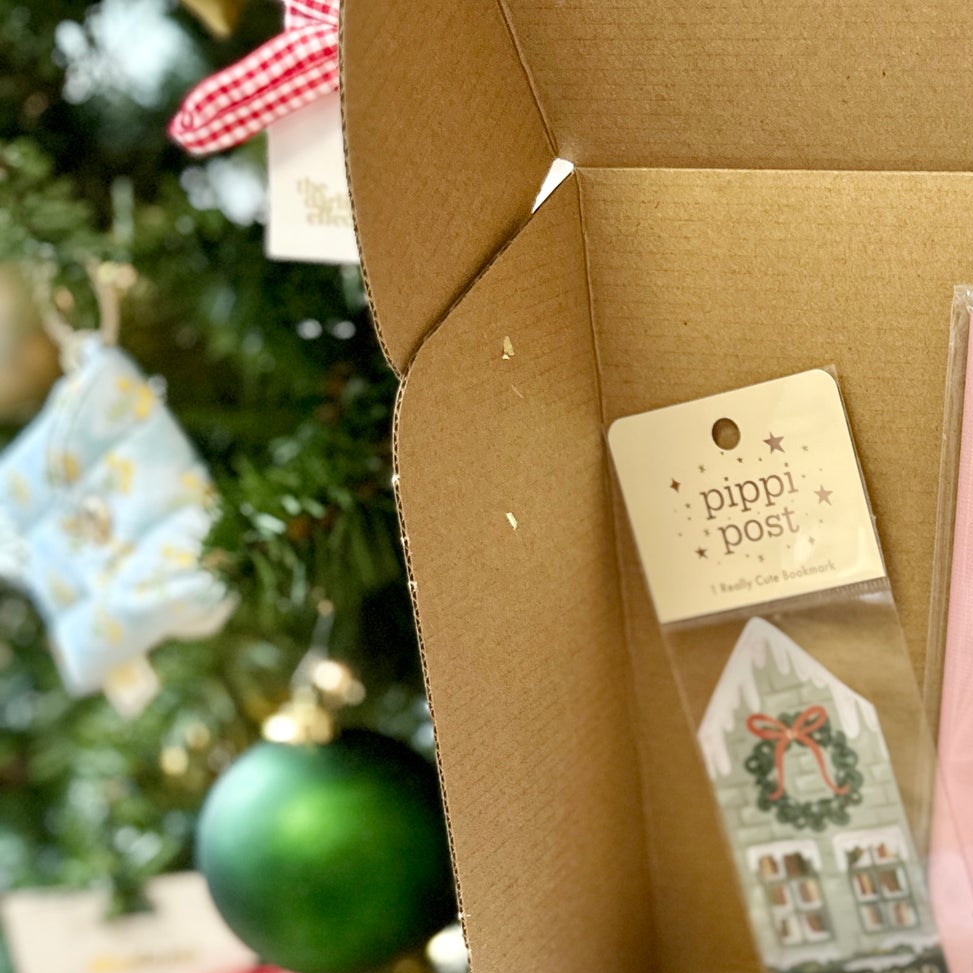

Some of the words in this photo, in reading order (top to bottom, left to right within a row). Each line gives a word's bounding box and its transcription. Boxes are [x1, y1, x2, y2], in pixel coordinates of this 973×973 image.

[700, 462, 798, 520] pippi
[718, 506, 800, 555] post
[720, 578, 752, 593] Really
[755, 574, 779, 586] Cute
[782, 560, 836, 581] Bookmark
